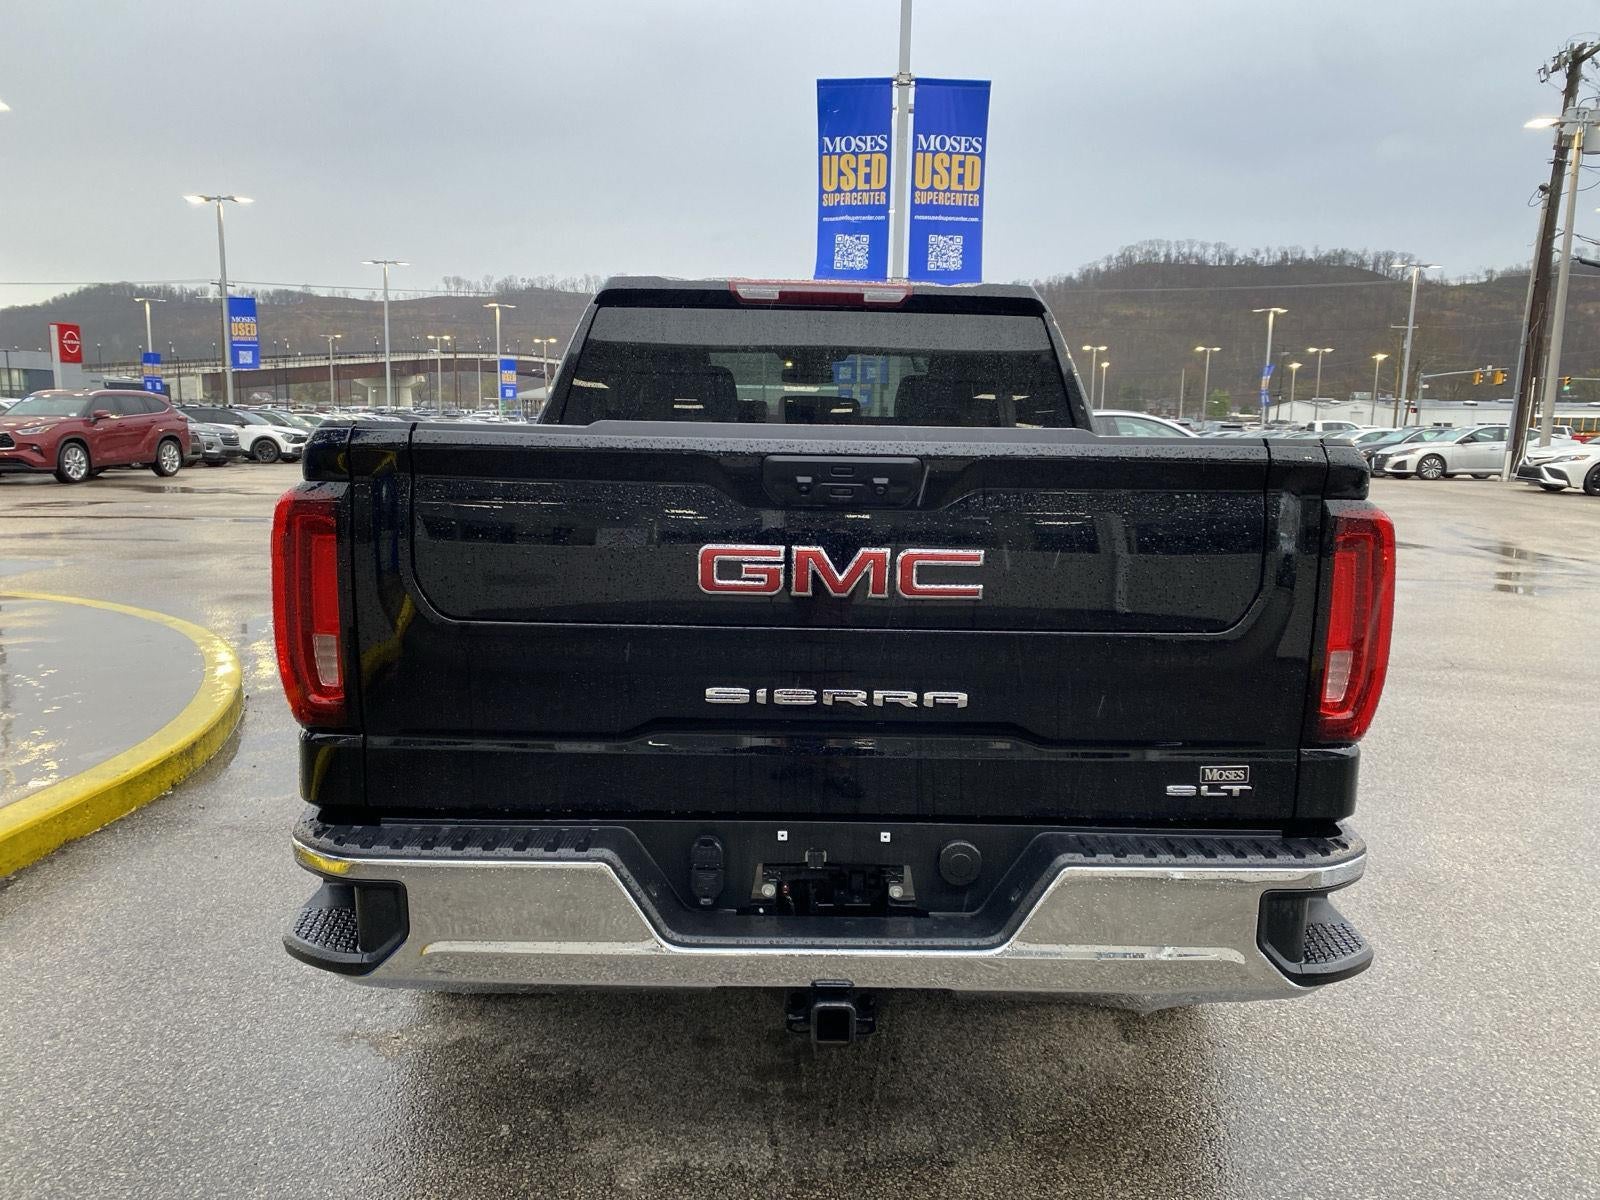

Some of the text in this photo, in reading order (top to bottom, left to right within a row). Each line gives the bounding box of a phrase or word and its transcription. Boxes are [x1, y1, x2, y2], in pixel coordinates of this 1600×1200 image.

[823, 135, 888, 154] MOSES
[917, 134, 982, 154] MOSES
[822, 153, 888, 192] USED
[915, 153, 981, 192] USED
[822, 191, 886, 206] SUPERCENTER
[914, 191, 980, 206] SUPERCENTER
[231, 322, 257, 336] USED
[698, 543, 985, 600] GMC
[705, 687, 968, 709] SIERRA
[1204, 768, 1245, 781] MOSES
[1166, 785, 1252, 797] SLT
